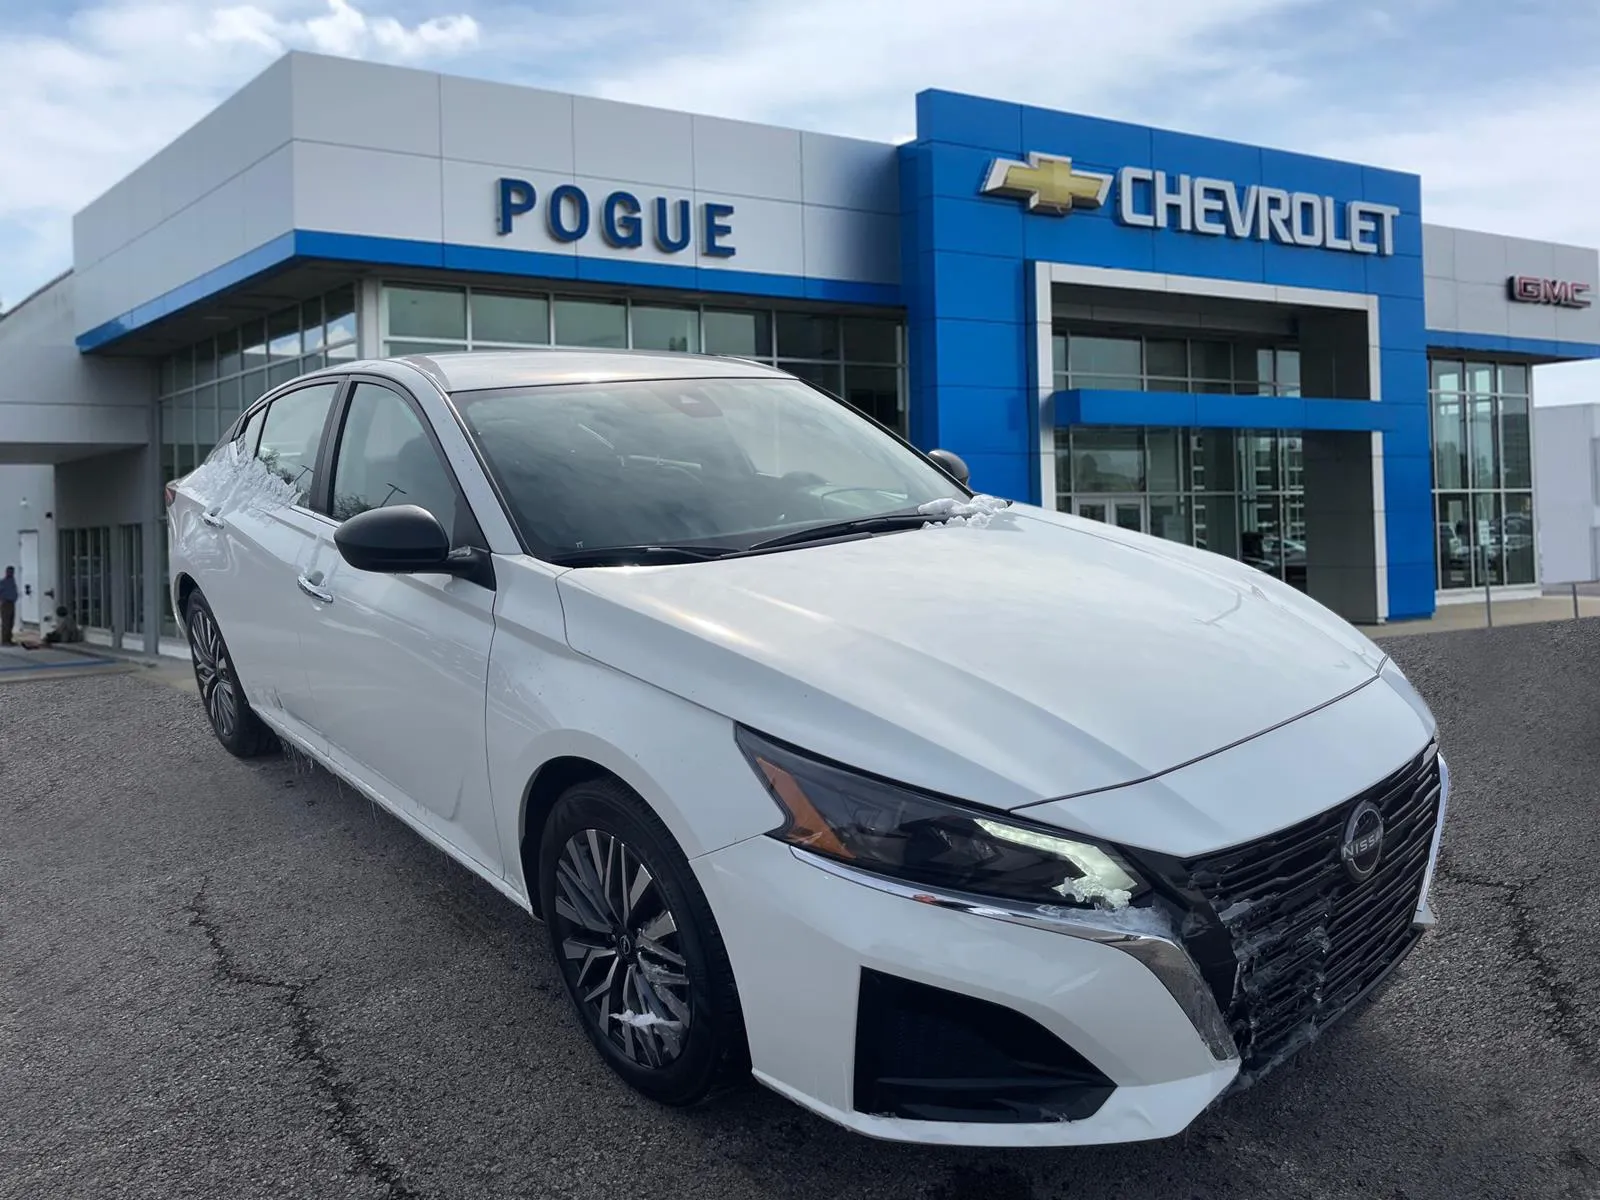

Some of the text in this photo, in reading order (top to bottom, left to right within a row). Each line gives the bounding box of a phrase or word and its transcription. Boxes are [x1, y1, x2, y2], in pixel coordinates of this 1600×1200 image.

[497, 177, 736, 256] POGUE
[1118, 166, 1400, 256] CHEVROLET
[1513, 275, 1591, 308] GMC
